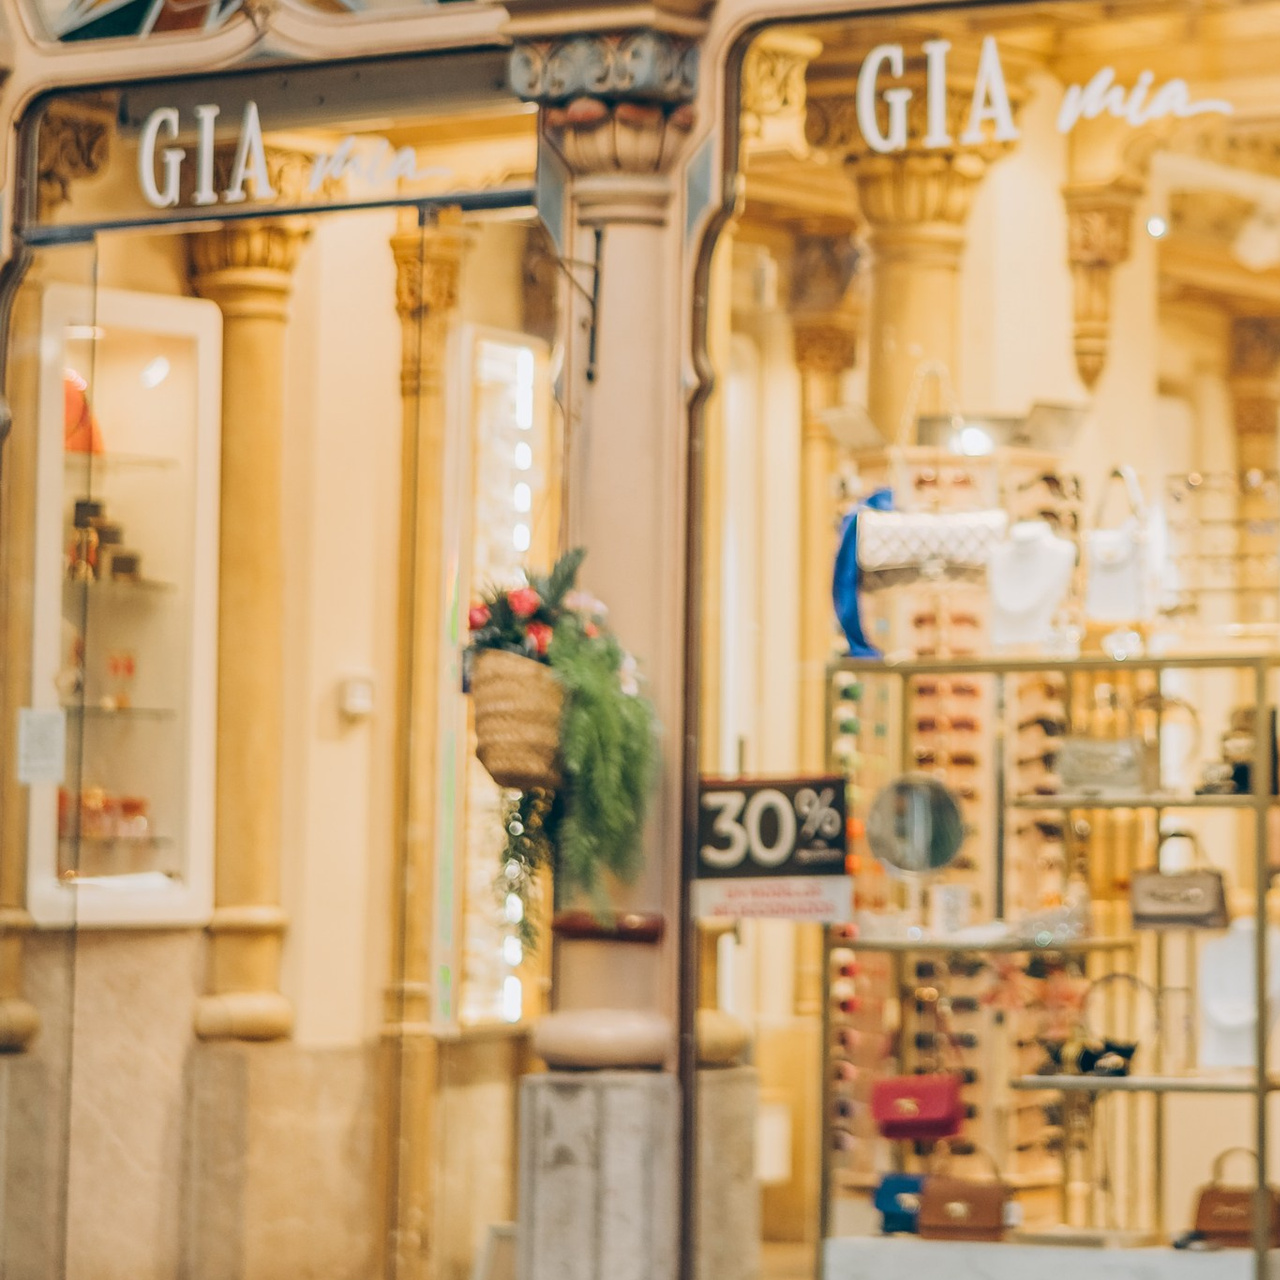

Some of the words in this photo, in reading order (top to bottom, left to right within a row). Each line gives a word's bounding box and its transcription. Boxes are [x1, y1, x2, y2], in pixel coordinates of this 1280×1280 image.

[856, 35, 1019, 153] GIA
[138, 99, 276, 208] GIA
[701, 787, 842, 869] 30%
